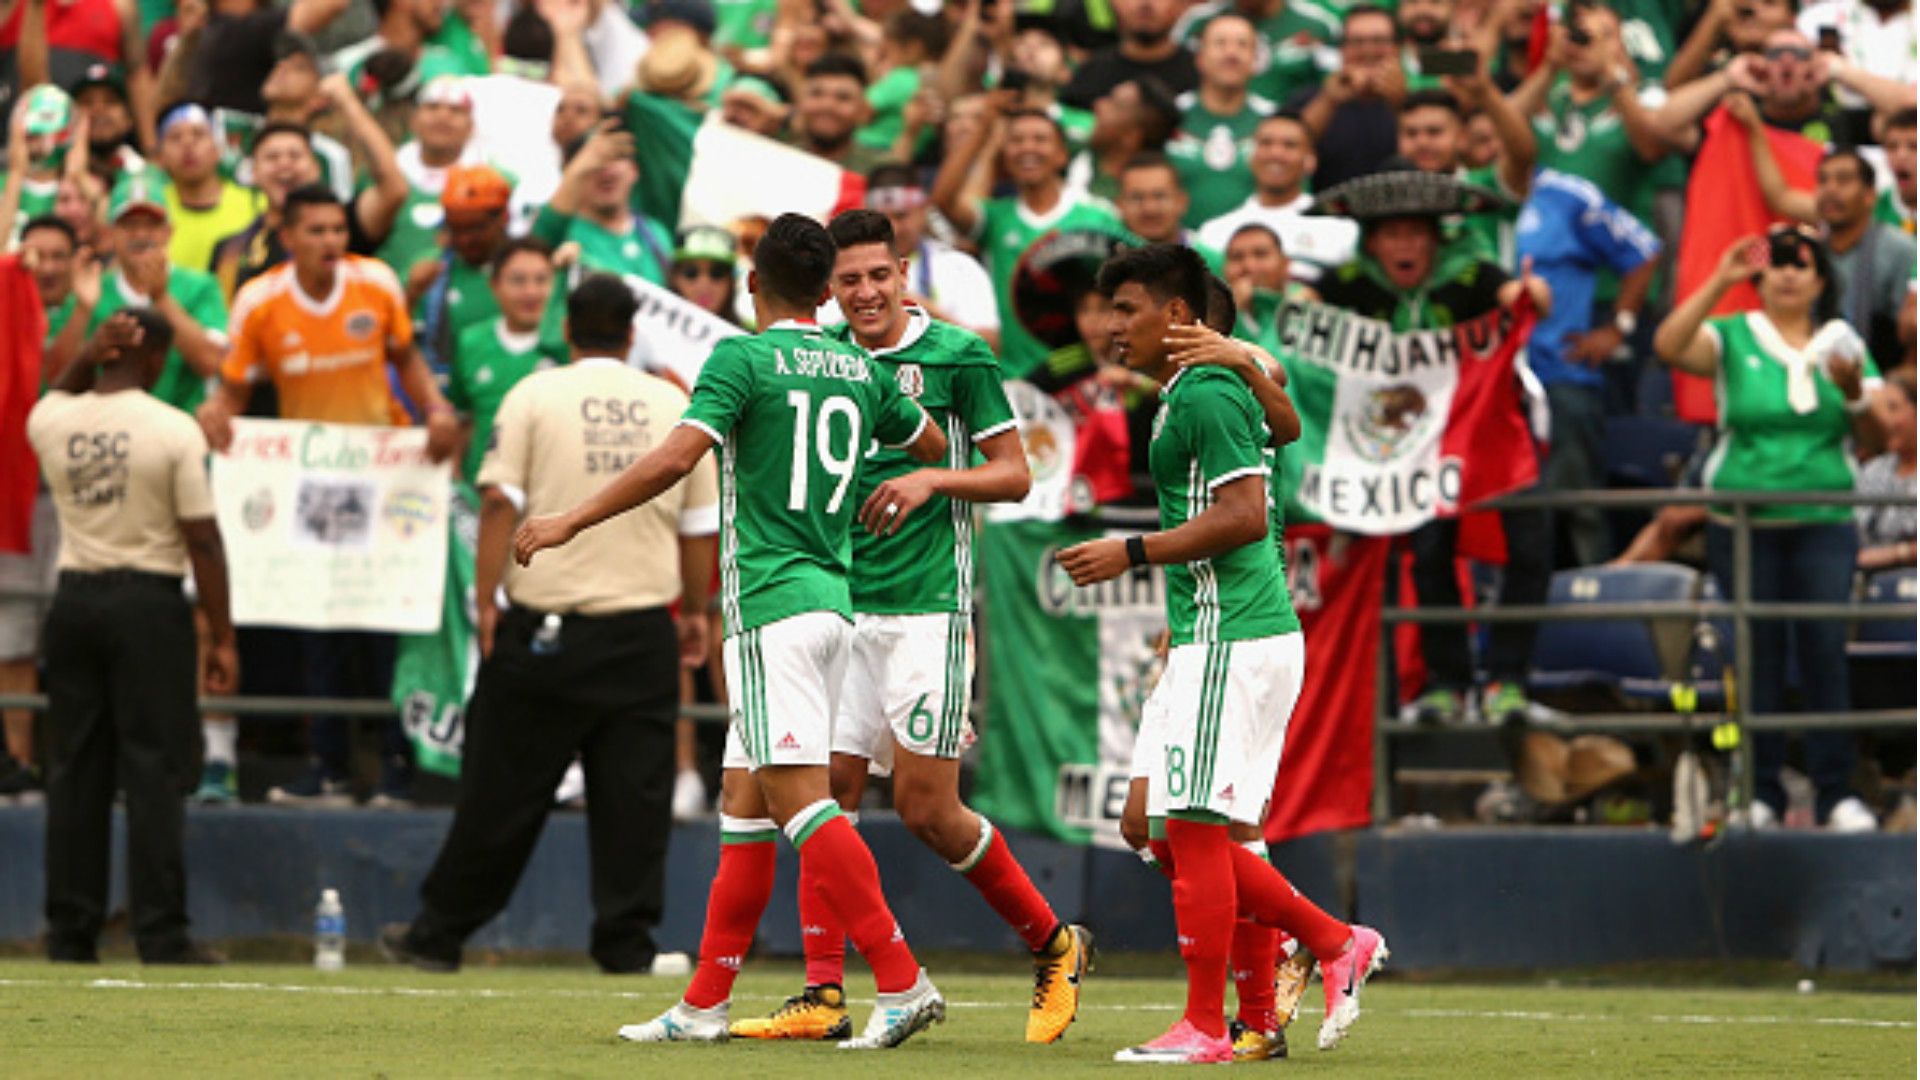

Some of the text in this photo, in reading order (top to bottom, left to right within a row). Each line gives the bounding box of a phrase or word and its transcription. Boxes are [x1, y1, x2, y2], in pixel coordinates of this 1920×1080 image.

[581, 396, 649, 426] CSC
[67, 430, 129, 460] CSC
[585, 450, 640, 474] STAF
[788, 389, 861, 514] 19
[1303, 462, 1461, 516] MEXICO
[907, 692, 934, 743] 6
